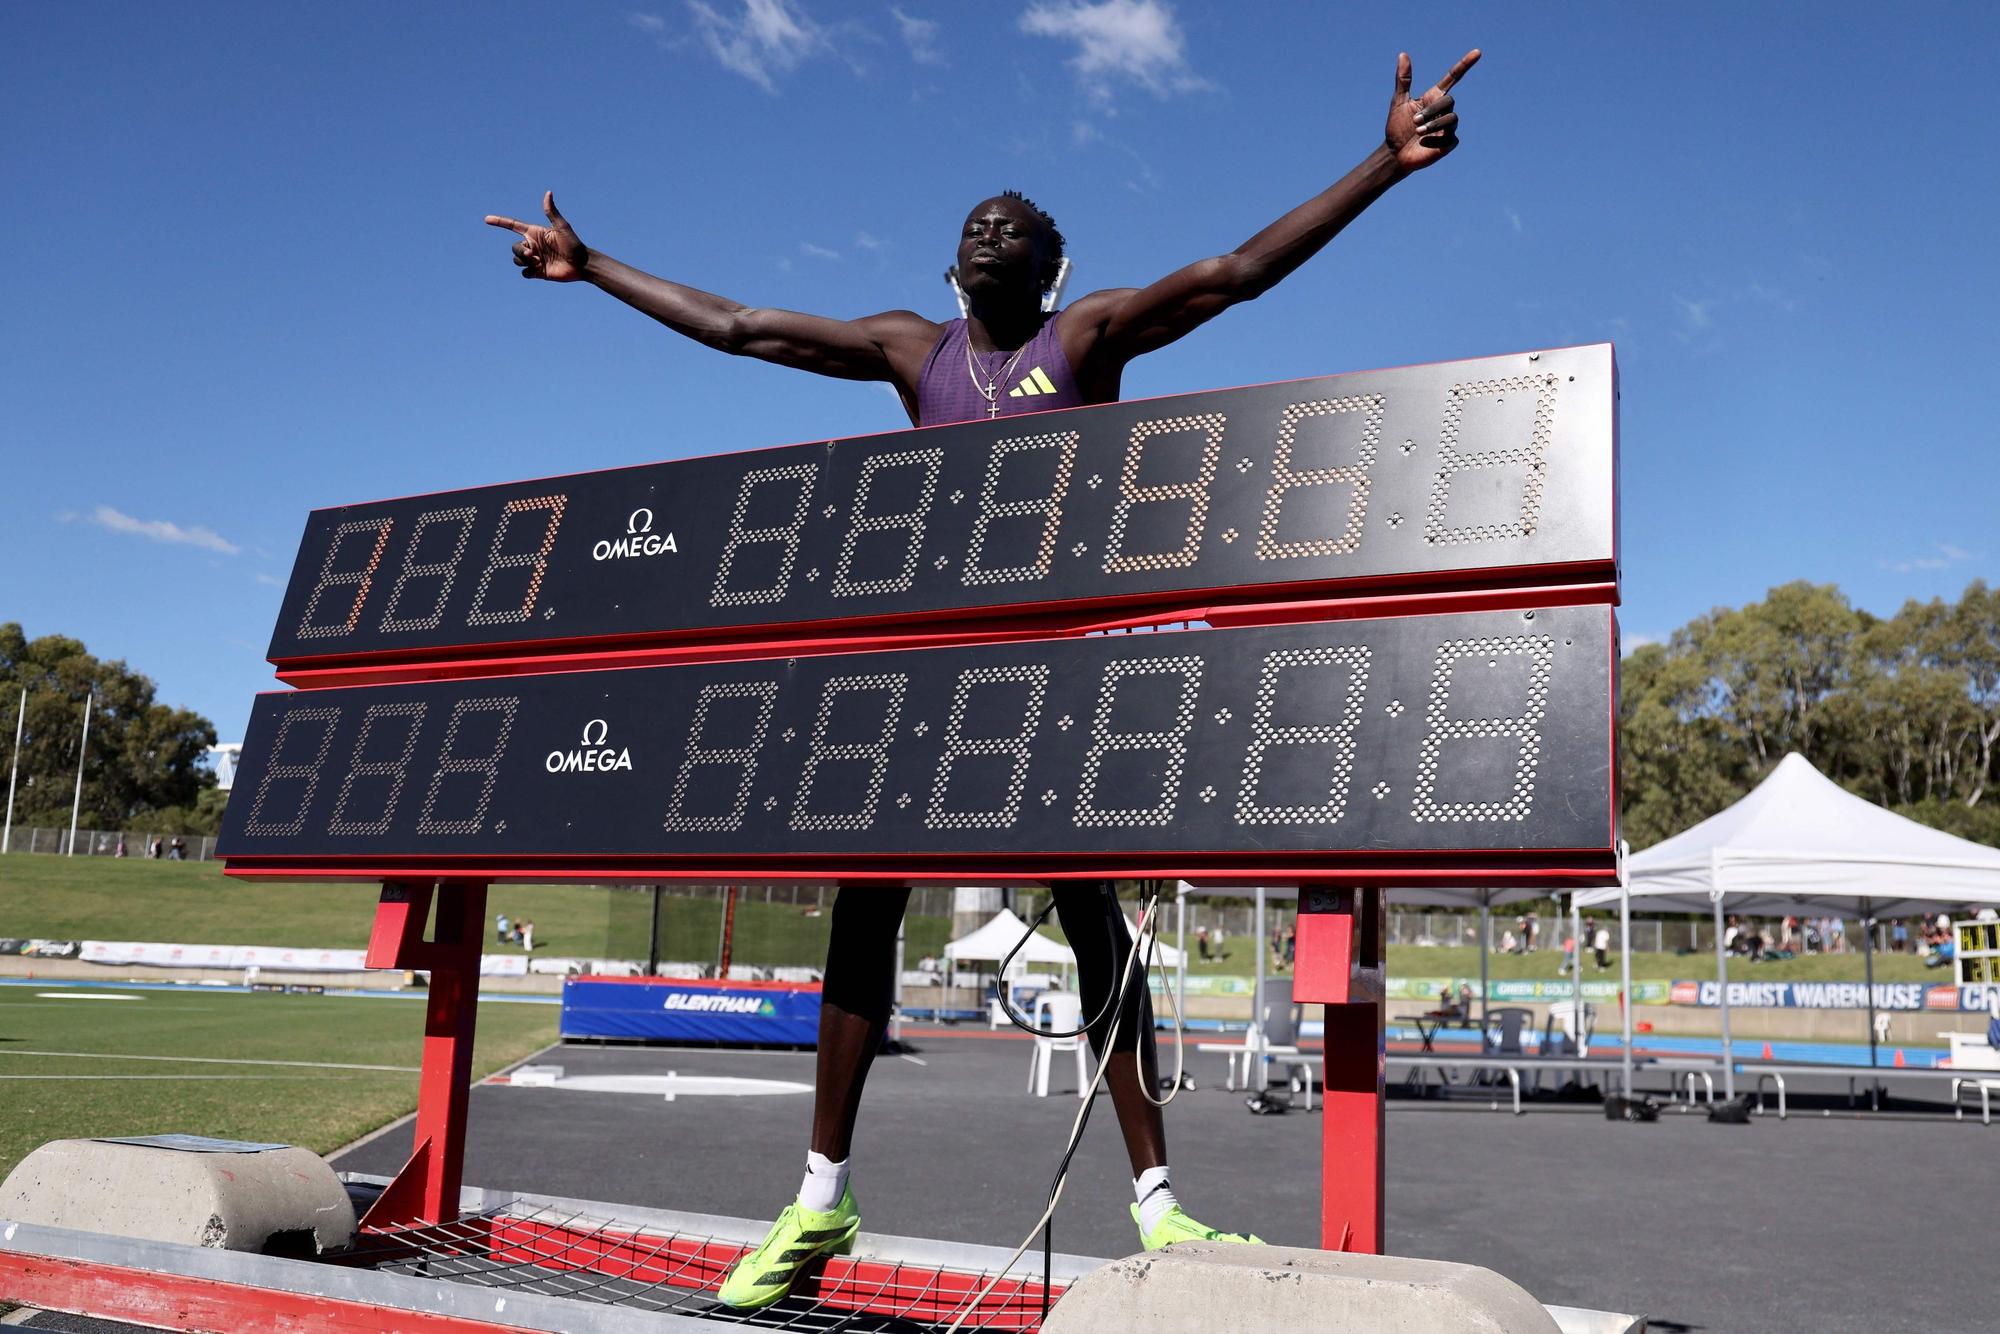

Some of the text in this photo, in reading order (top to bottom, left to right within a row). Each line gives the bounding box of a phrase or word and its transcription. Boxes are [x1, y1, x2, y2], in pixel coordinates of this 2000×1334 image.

[593, 532, 678, 561] OMEGA
[546, 747, 633, 773] OMEGA
[664, 993, 762, 1014] GLENTHAM
[1792, 982, 1922, 1010] WAREHOUSE
